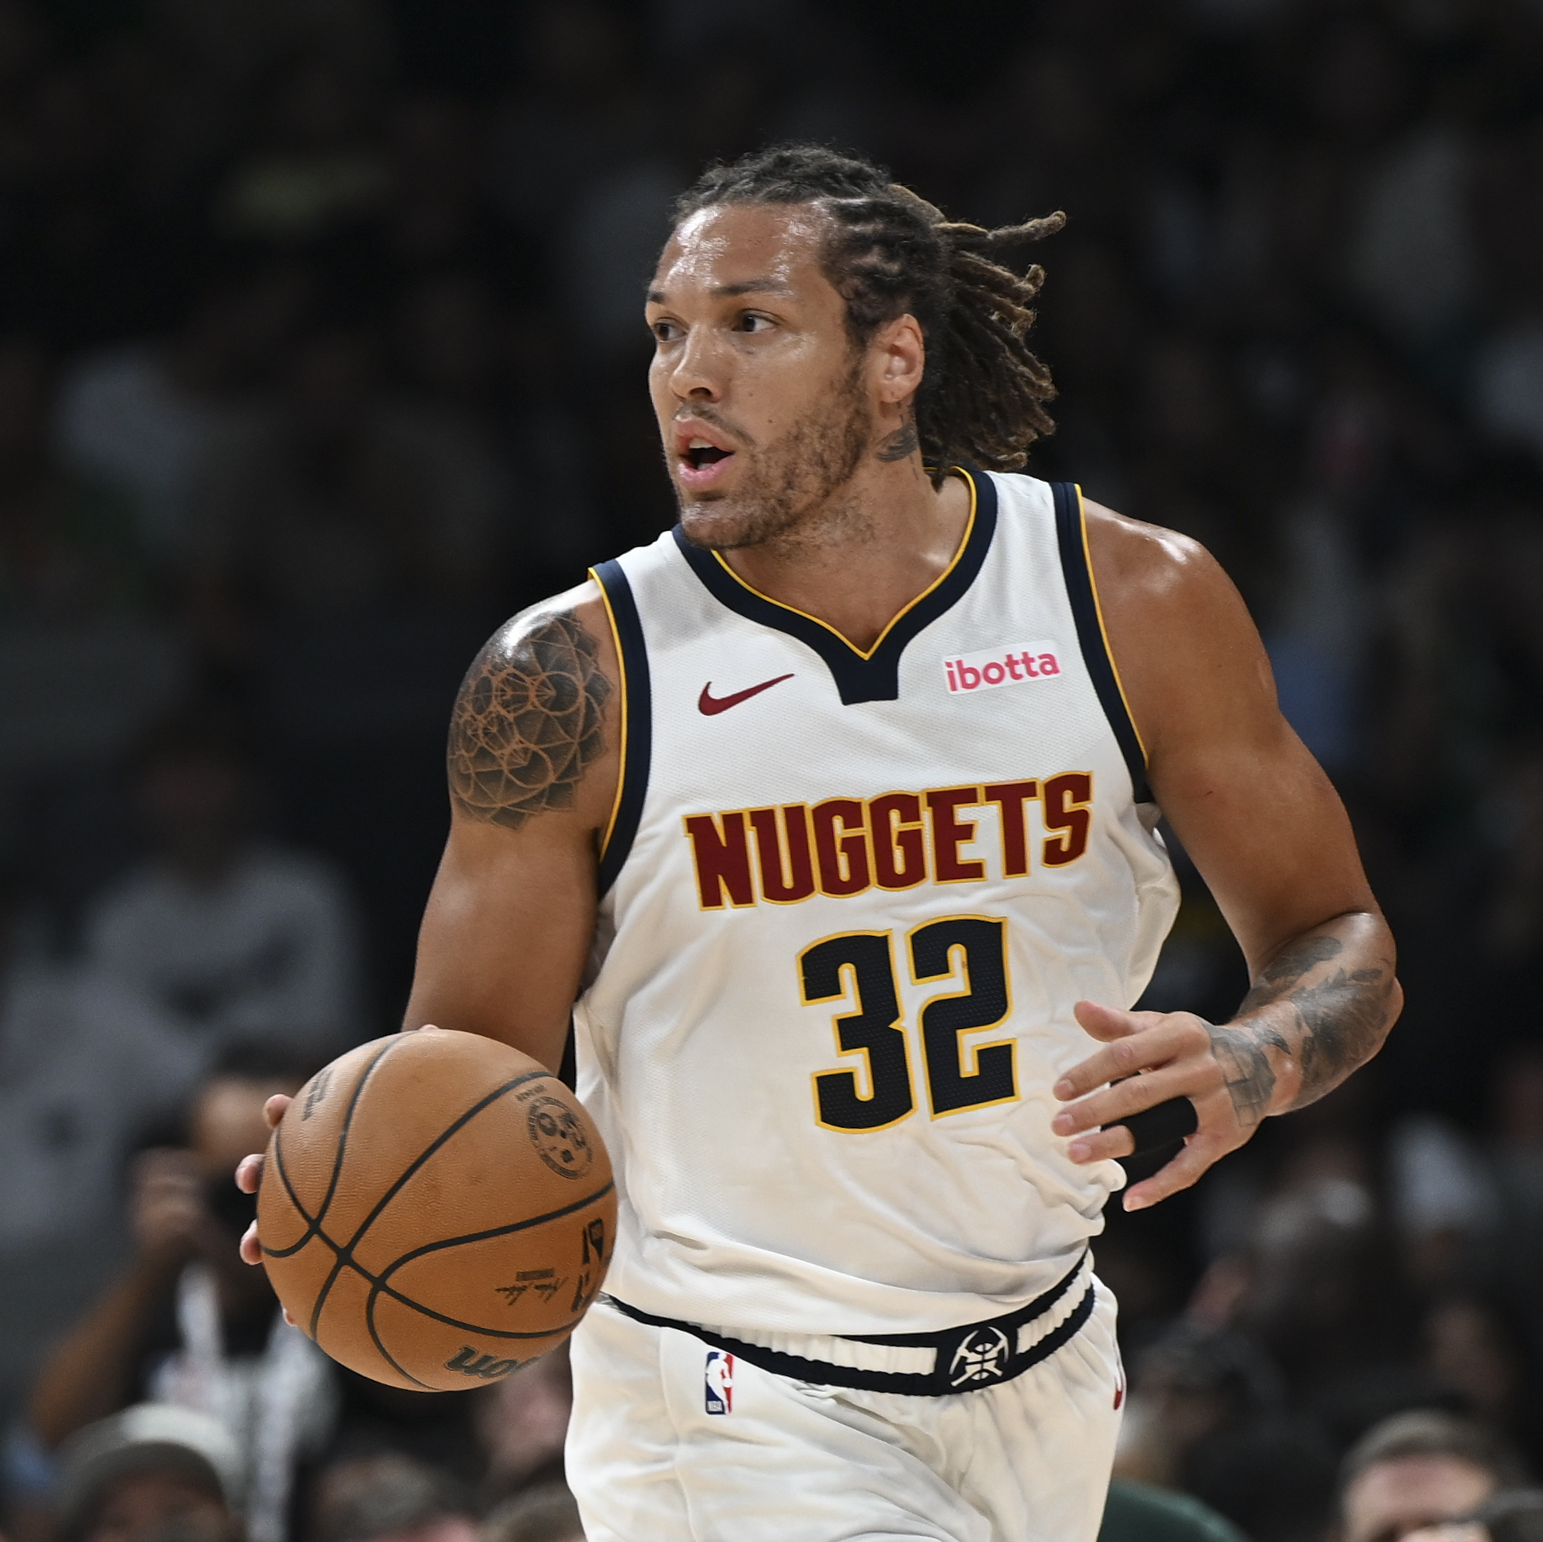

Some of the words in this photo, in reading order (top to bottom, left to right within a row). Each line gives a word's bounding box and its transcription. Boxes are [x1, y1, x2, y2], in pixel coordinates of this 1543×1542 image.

[944, 650, 1060, 692] ibotta
[682, 771, 1094, 911] NUGGETS
[796, 914, 1019, 1135] 32
